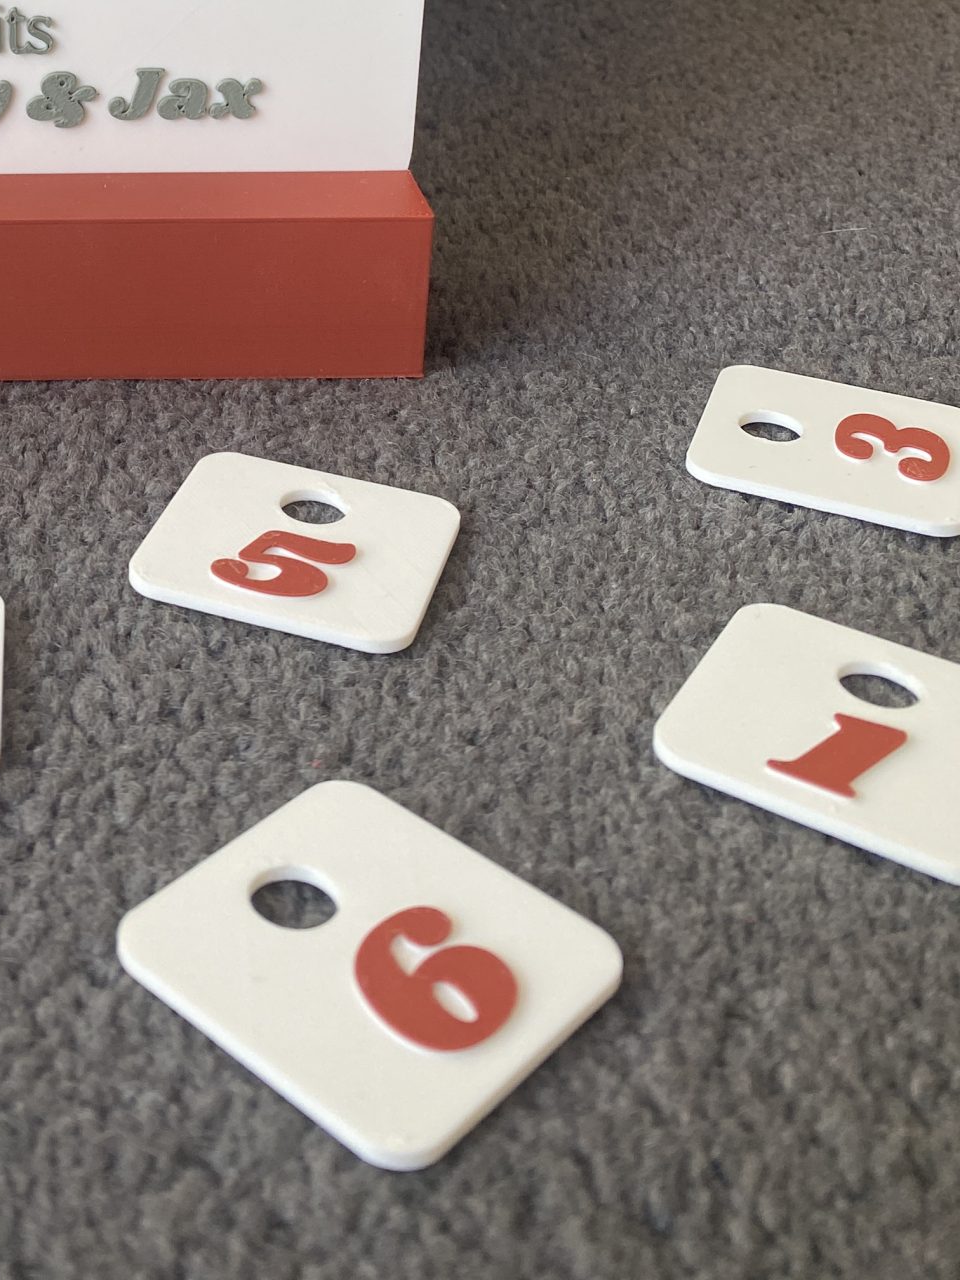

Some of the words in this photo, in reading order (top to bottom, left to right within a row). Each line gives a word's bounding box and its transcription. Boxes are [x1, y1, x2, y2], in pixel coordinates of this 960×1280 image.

[25, 70, 97, 129] &
[108, 67, 264, 122] Jax
[834, 413, 951, 482] 3
[210, 530, 357, 597] 5
[767, 713, 908, 797] 1
[355, 906, 519, 1052] 6
